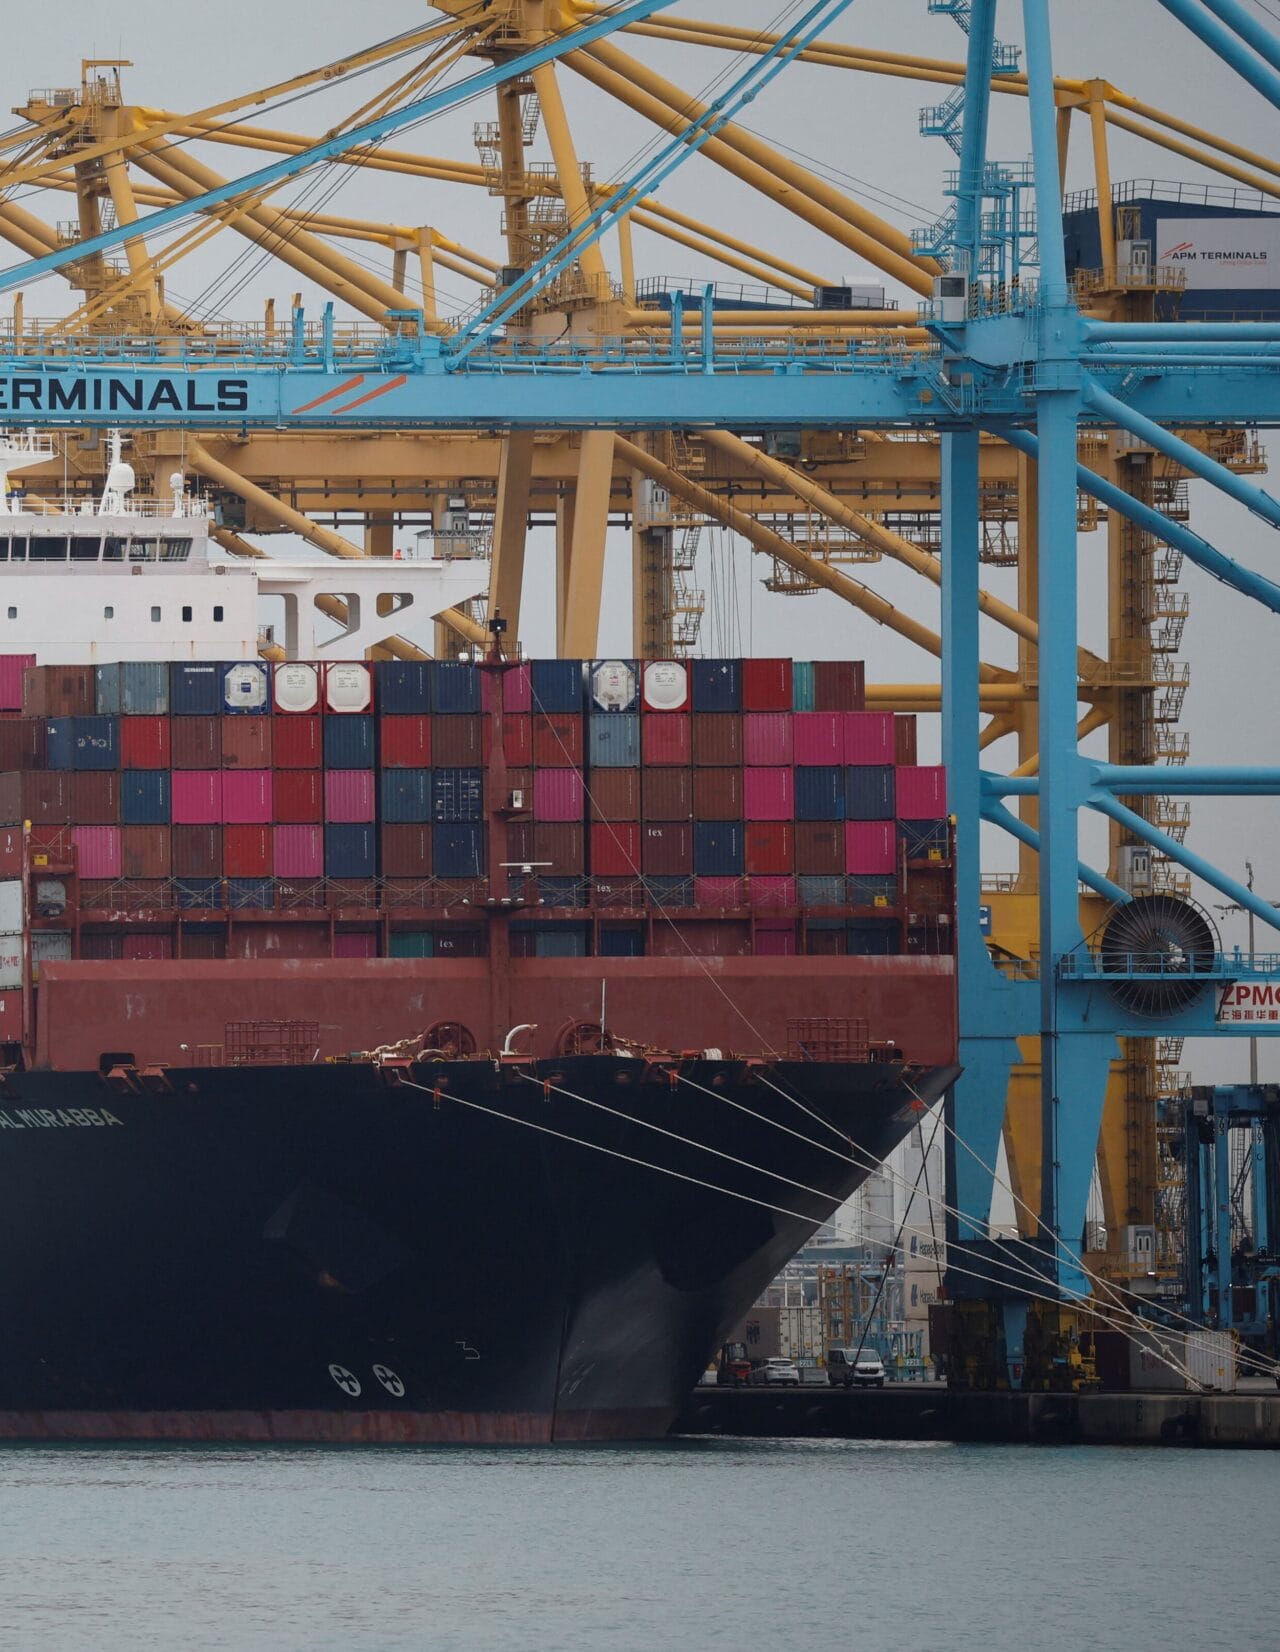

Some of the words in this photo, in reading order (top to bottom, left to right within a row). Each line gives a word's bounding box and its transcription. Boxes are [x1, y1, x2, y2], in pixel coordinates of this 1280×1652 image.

[1172, 252, 1197, 260] APM
[1200, 252, 1267, 260] TERMINALS
[648, 828, 662, 837] tex
[597, 885, 611, 893] tex
[439, 940, 454, 948] tex
[907, 936, 919, 944] ex
